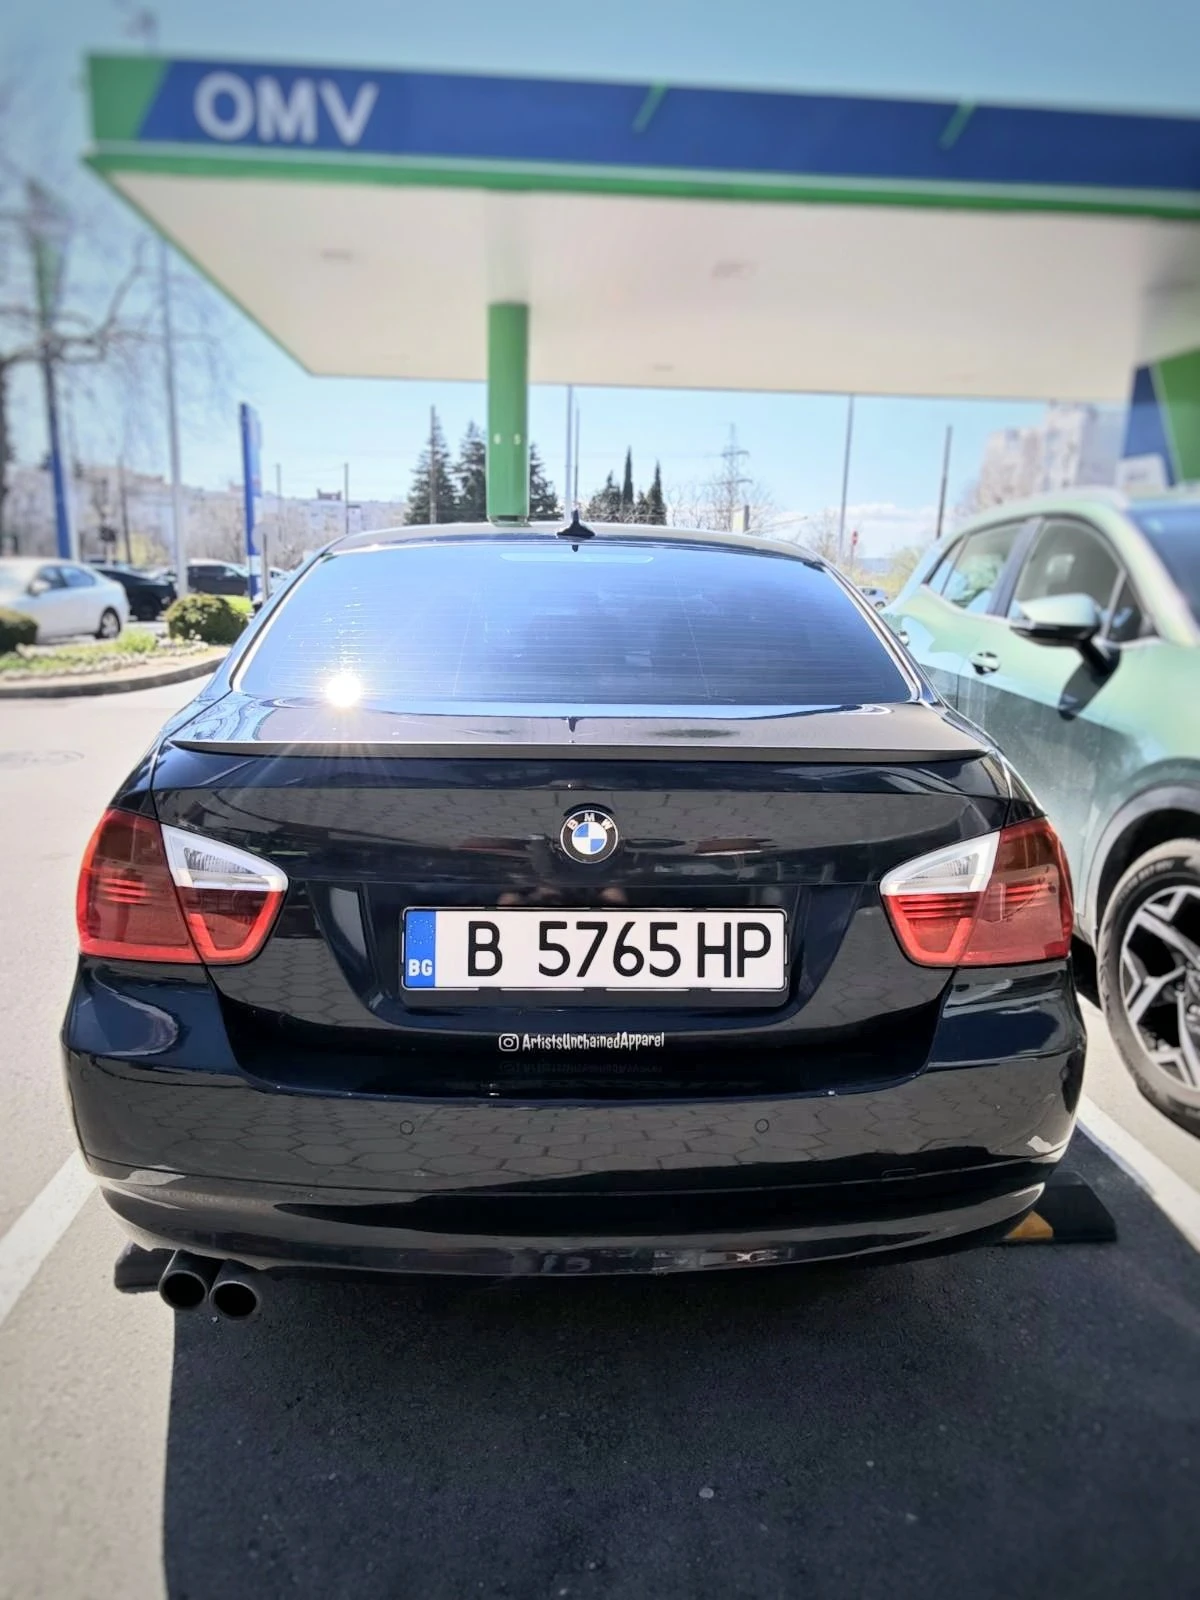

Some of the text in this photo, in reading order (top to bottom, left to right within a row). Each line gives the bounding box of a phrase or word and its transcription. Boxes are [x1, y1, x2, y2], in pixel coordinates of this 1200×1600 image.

[193, 70, 379, 146] OMV
[566, 812, 613, 831] BMW
[408, 959, 433, 976] BG
[467, 920, 772, 978] B 5765 HP
